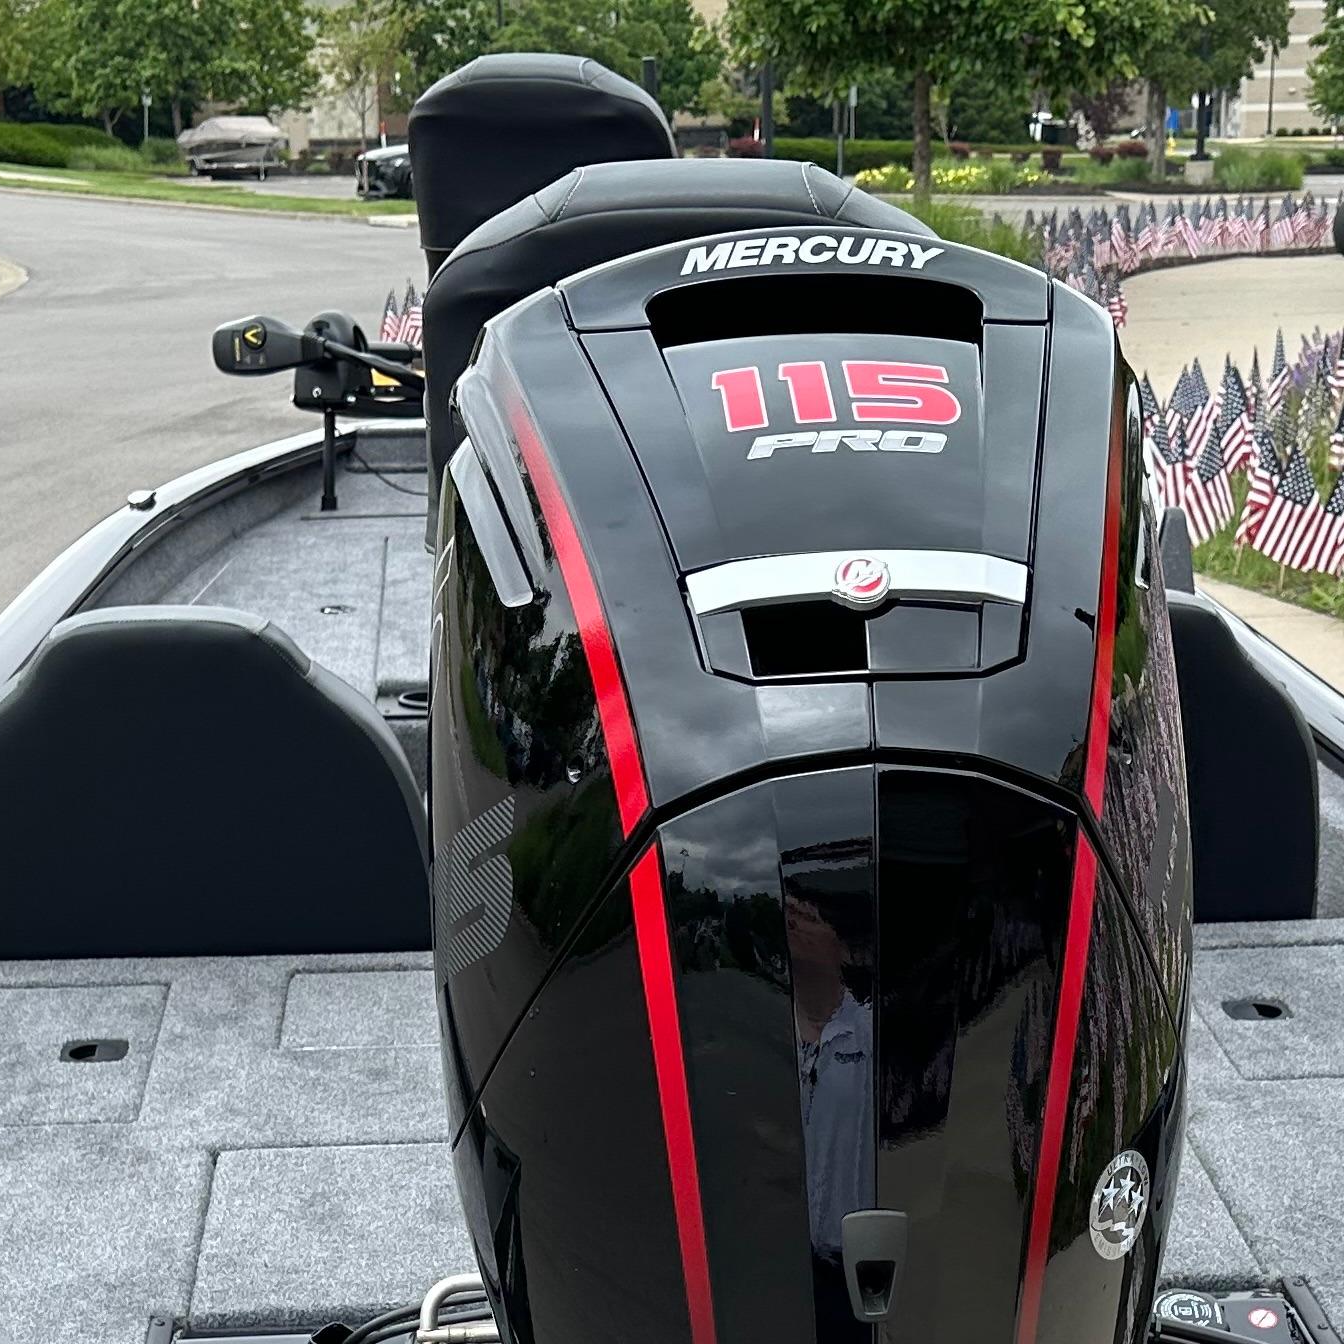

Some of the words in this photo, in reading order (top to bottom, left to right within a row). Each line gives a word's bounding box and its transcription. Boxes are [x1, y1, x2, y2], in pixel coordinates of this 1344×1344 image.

[679, 234, 945, 276] MERCURY
[711, 360, 962, 433] 115
[746, 429, 948, 460] PRO
